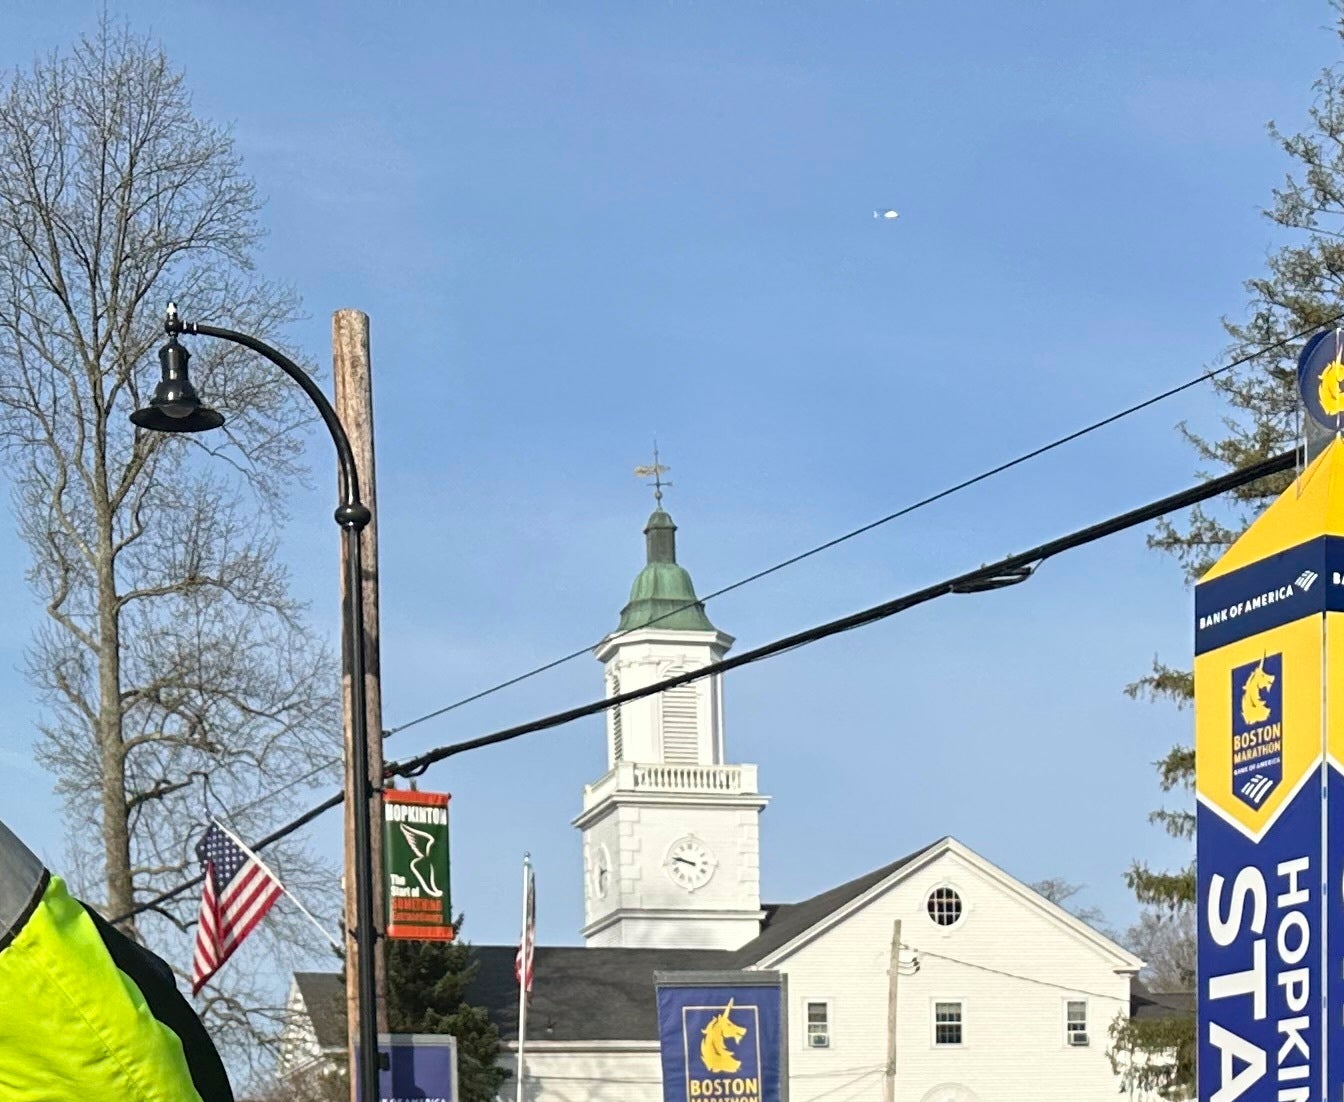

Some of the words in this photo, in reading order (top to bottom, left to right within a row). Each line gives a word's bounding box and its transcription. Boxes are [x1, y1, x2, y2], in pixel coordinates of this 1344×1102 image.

[1199, 608, 1228, 630] BANK
[1229, 602, 1244, 618] OF
[1244, 584, 1294, 613] AMERICA
[1233, 721, 1281, 751] BOSTON
[1233, 740, 1281, 765] MARATHON
[384, 803, 448, 825] HOPKINTON
[690, 1078, 758, 1096] BOSTON
